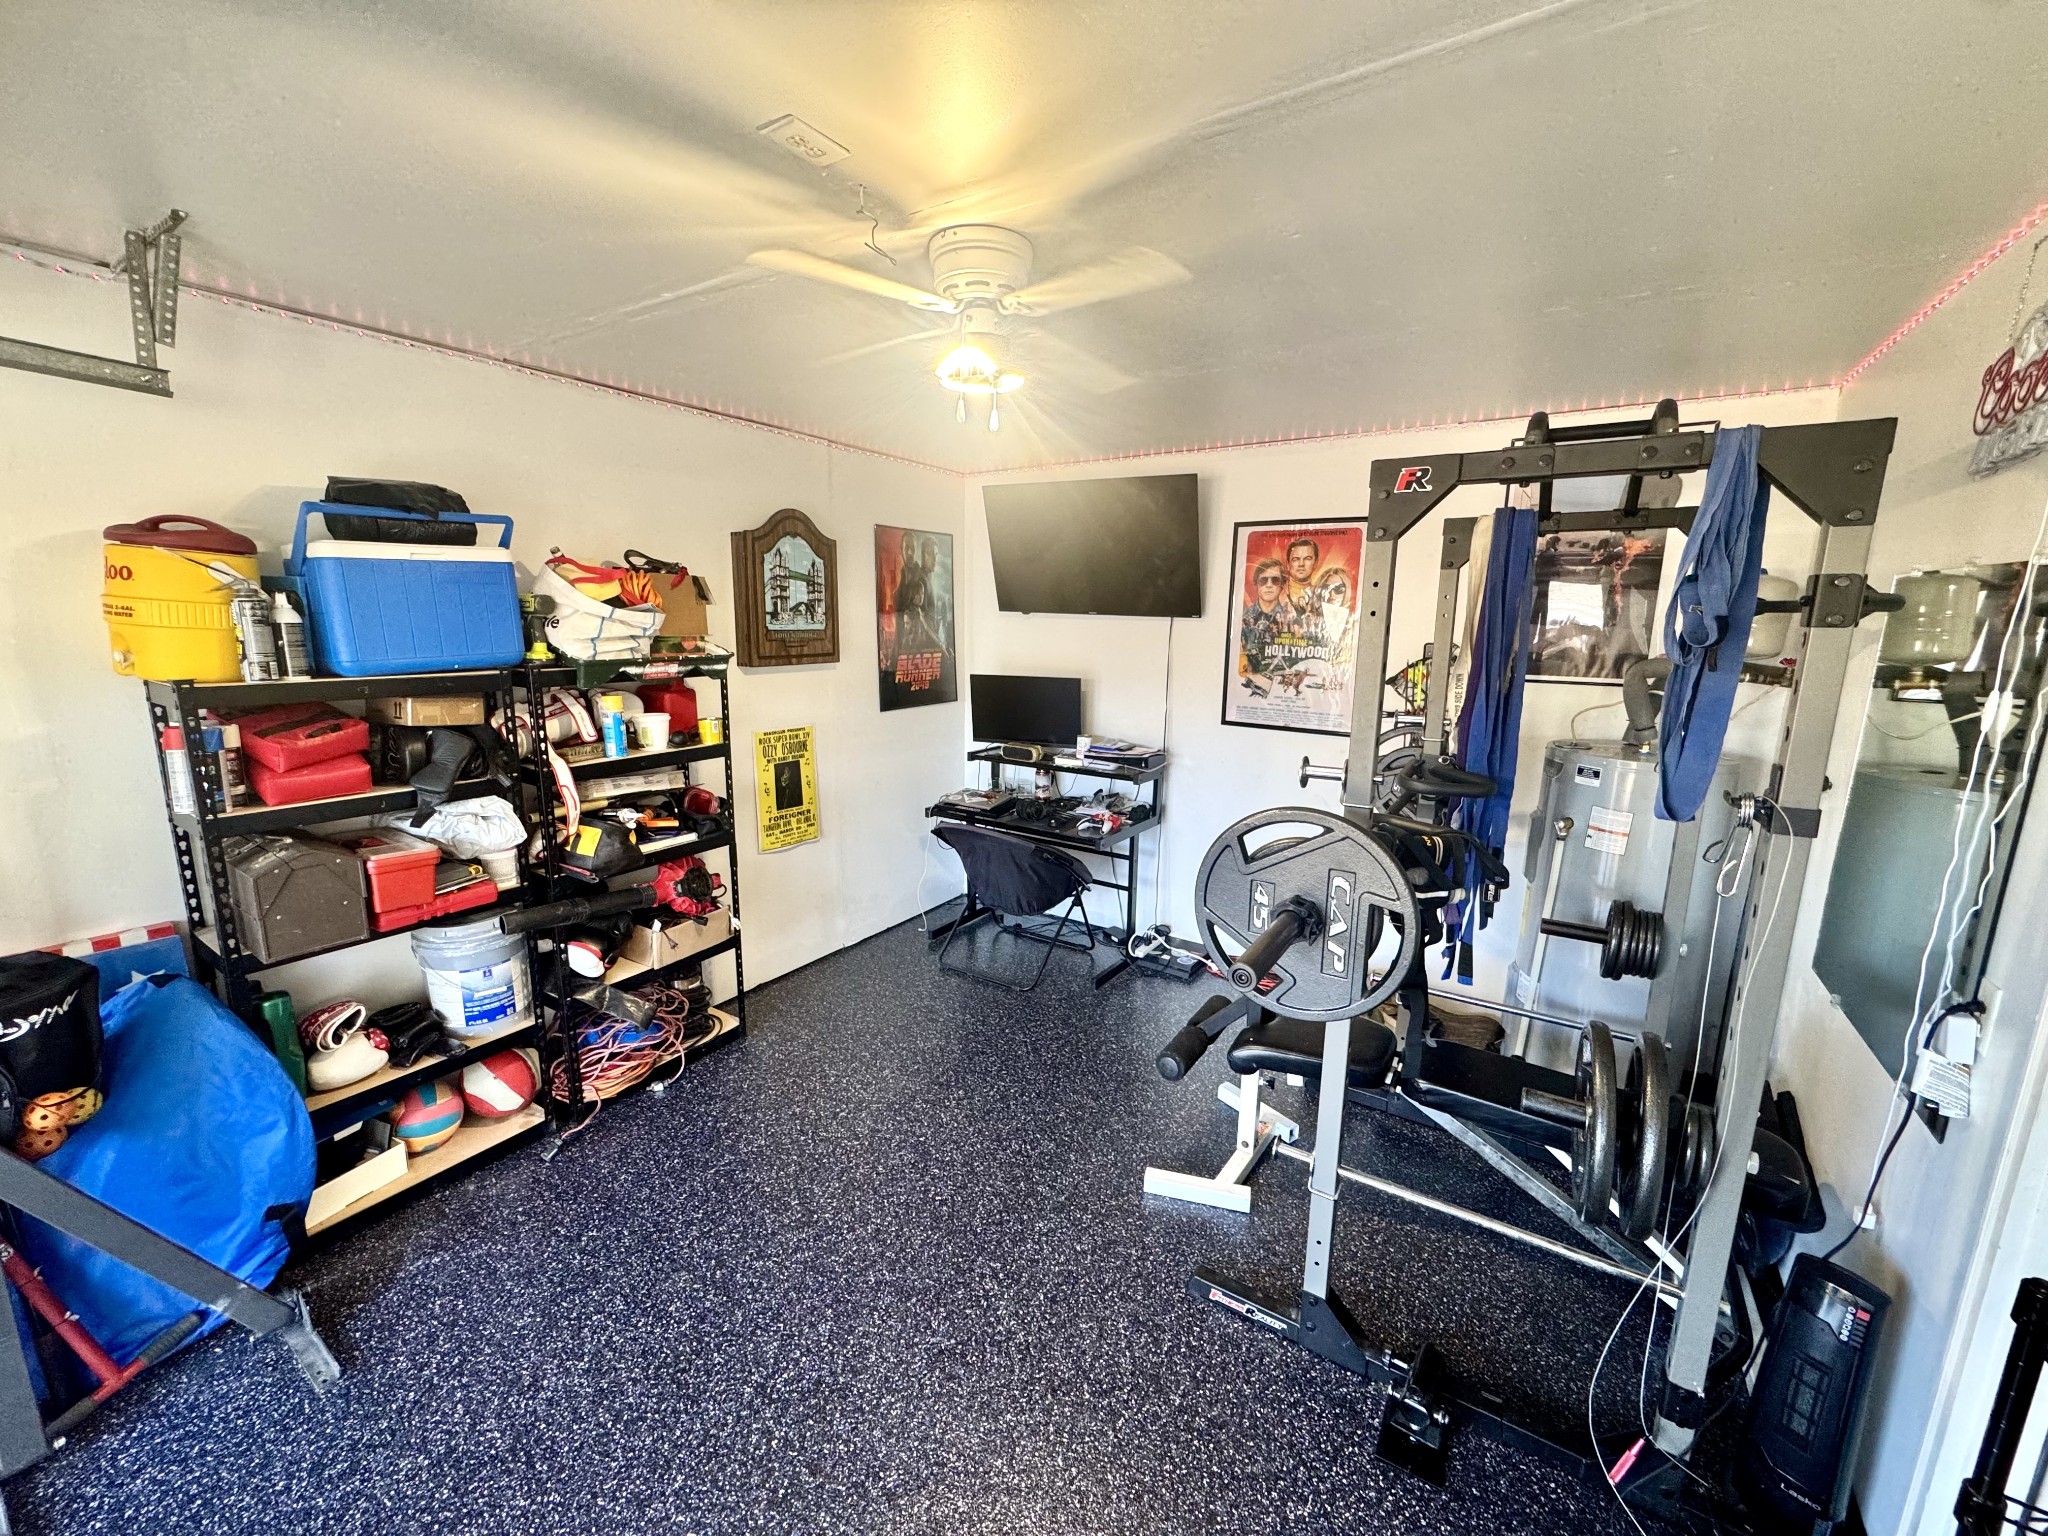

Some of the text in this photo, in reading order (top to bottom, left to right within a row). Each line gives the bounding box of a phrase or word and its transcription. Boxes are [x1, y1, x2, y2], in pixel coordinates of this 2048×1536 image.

[1264, 644, 1328, 660] HOLLYWOOD
[897, 652, 942, 671] BLADE
[895, 668, 941, 683] RUNNER
[1455, 691, 1463, 704] SIDE
[762, 743, 778, 759] OZZY
[768, 808, 812, 824] FOREIGNER
[1327, 875, 1351, 973] CAP
[1780, 1482, 1822, 1511] Lasko
